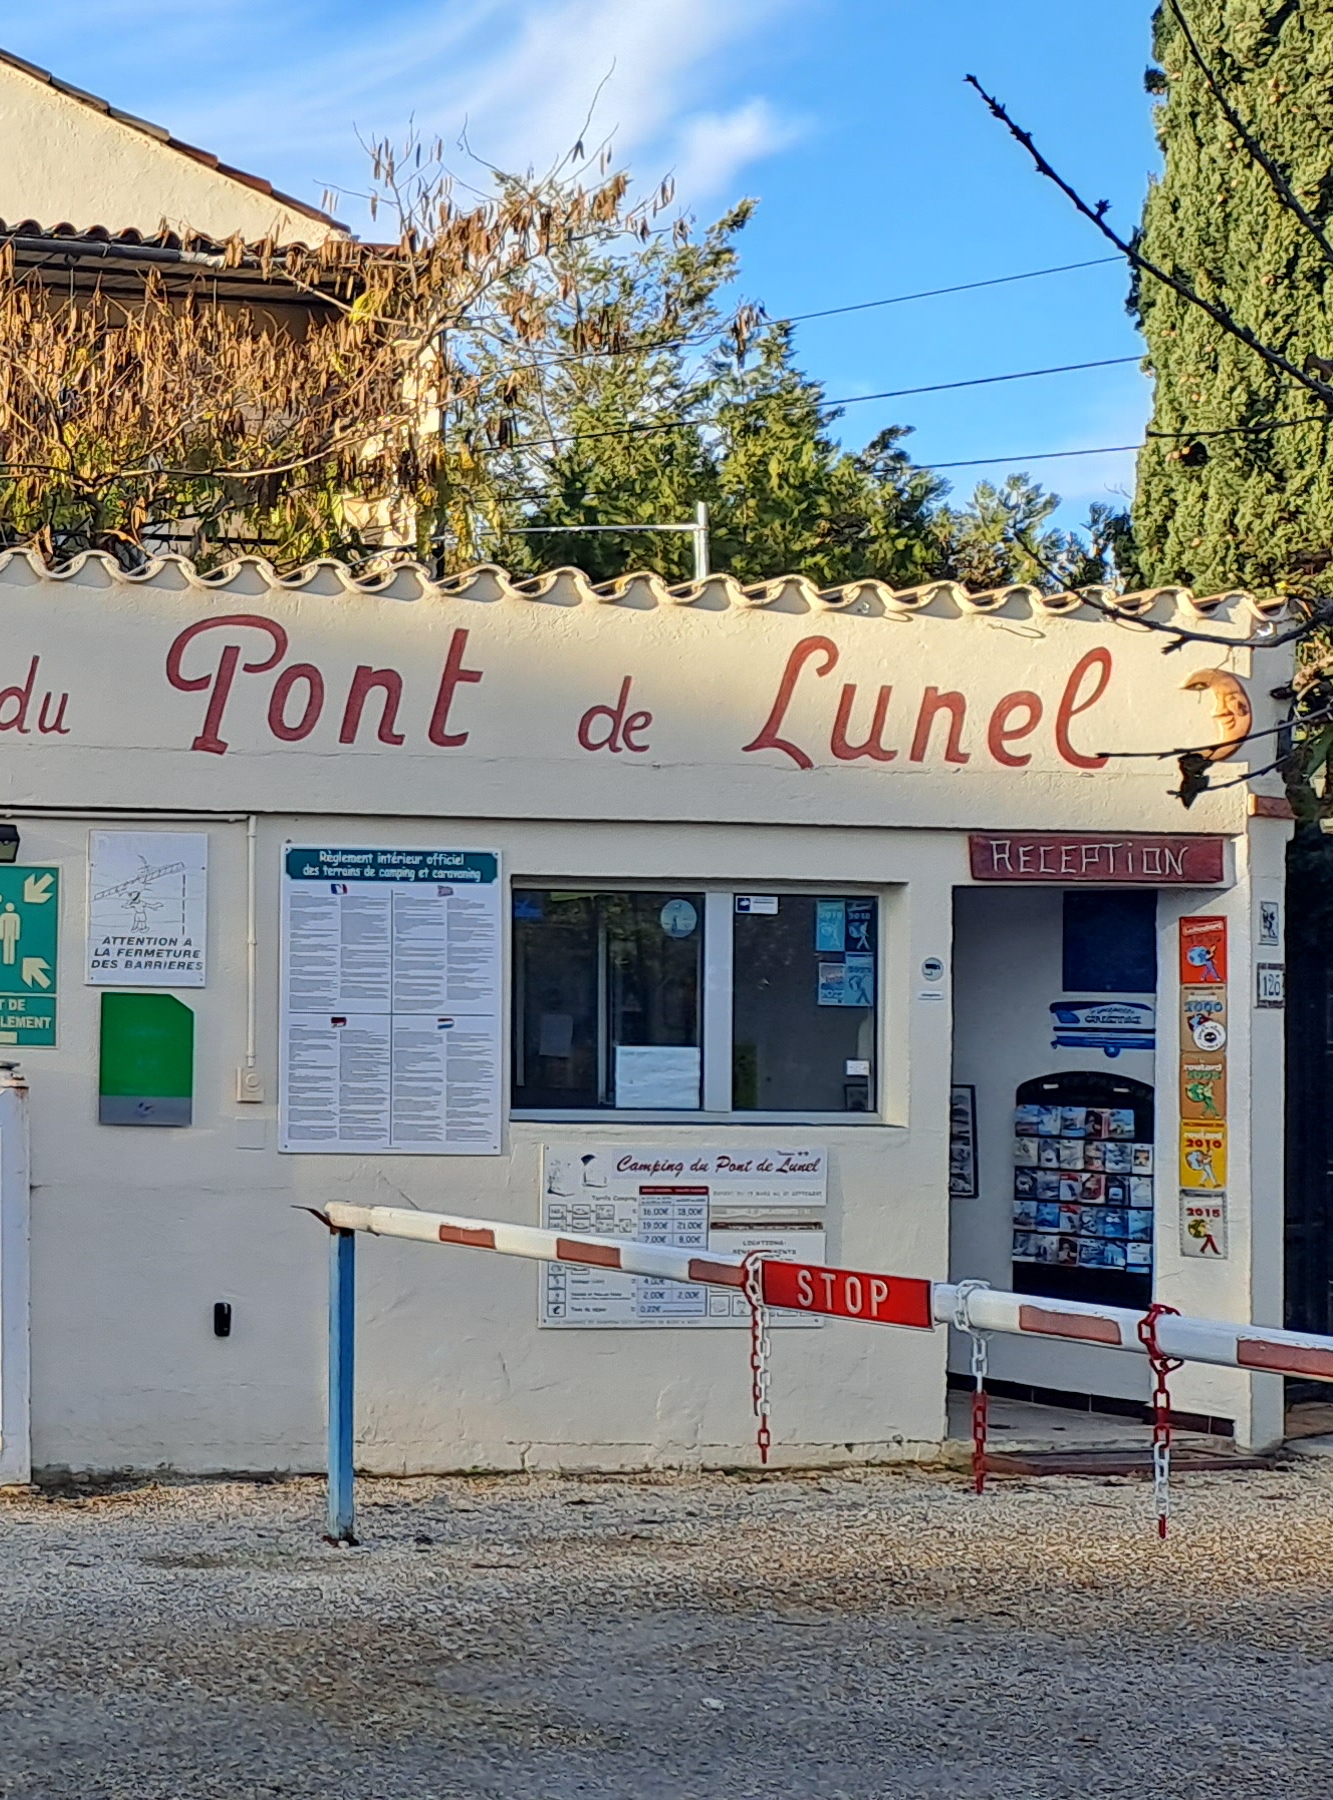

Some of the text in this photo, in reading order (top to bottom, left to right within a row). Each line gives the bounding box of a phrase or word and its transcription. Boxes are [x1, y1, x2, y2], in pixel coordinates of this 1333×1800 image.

[166, 614, 483, 756] Pont
[578, 675, 653, 754] de
[743, 634, 1114, 771] Lunel
[319, 851, 465, 867] Règlement intérieur officiel
[303, 864, 482, 882] des terrains de camping et caravaning
[101, 936, 192, 947] ATTENTION A
[94, 948, 201, 959] LA FERMETURE
[90, 959, 204, 971] DES BARRIERES
[8, 998, 26, 1012] DE
[1186, 1139, 1222, 1148] 2010
[616, 1155, 822, 1178] Camping du Pont de Lunel
[1186, 1207, 1221, 1218] 2015
[796, 1267, 889, 1317] STOP
